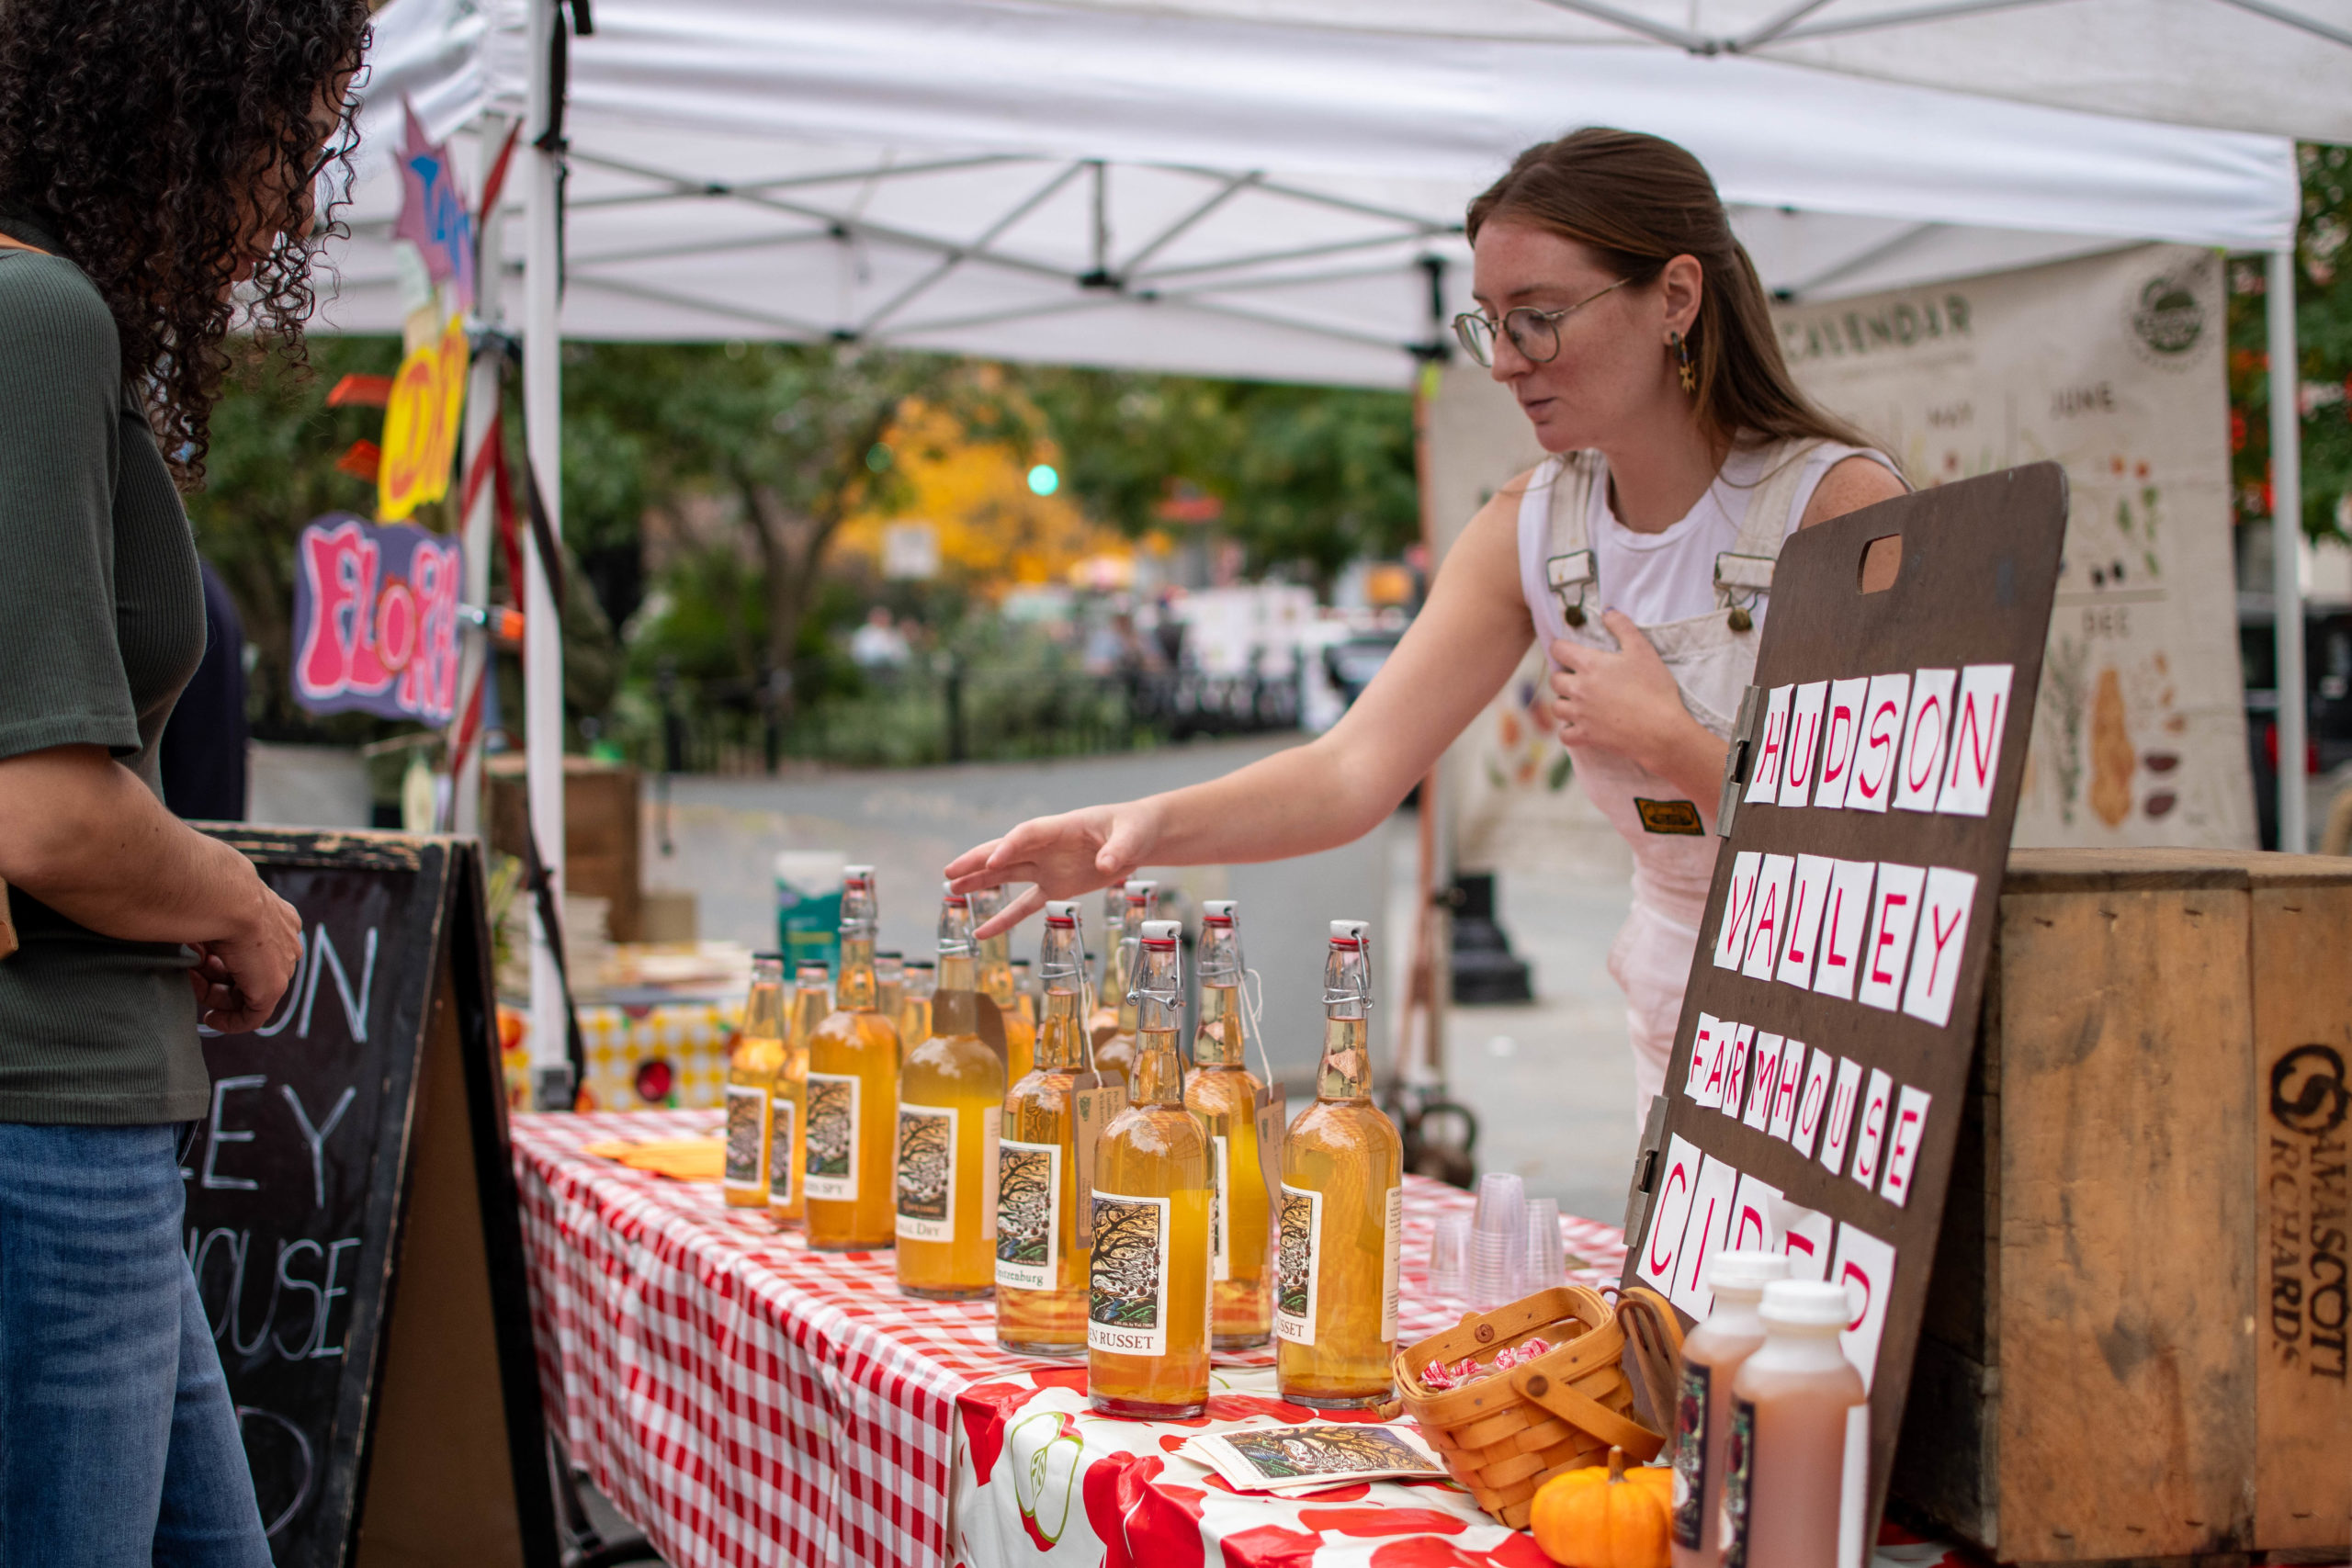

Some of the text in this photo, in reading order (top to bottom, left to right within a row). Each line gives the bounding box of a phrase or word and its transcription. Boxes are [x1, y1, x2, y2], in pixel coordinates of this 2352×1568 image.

[2052, 380, 2115, 421] JUNE
[1756, 691, 1999, 798] HUDSON
[1727, 874, 1962, 997] VALLEY
[1690, 1030, 1917, 1188] FARMHOUSE
[1100, 1332, 1154, 1348] RUSSET
